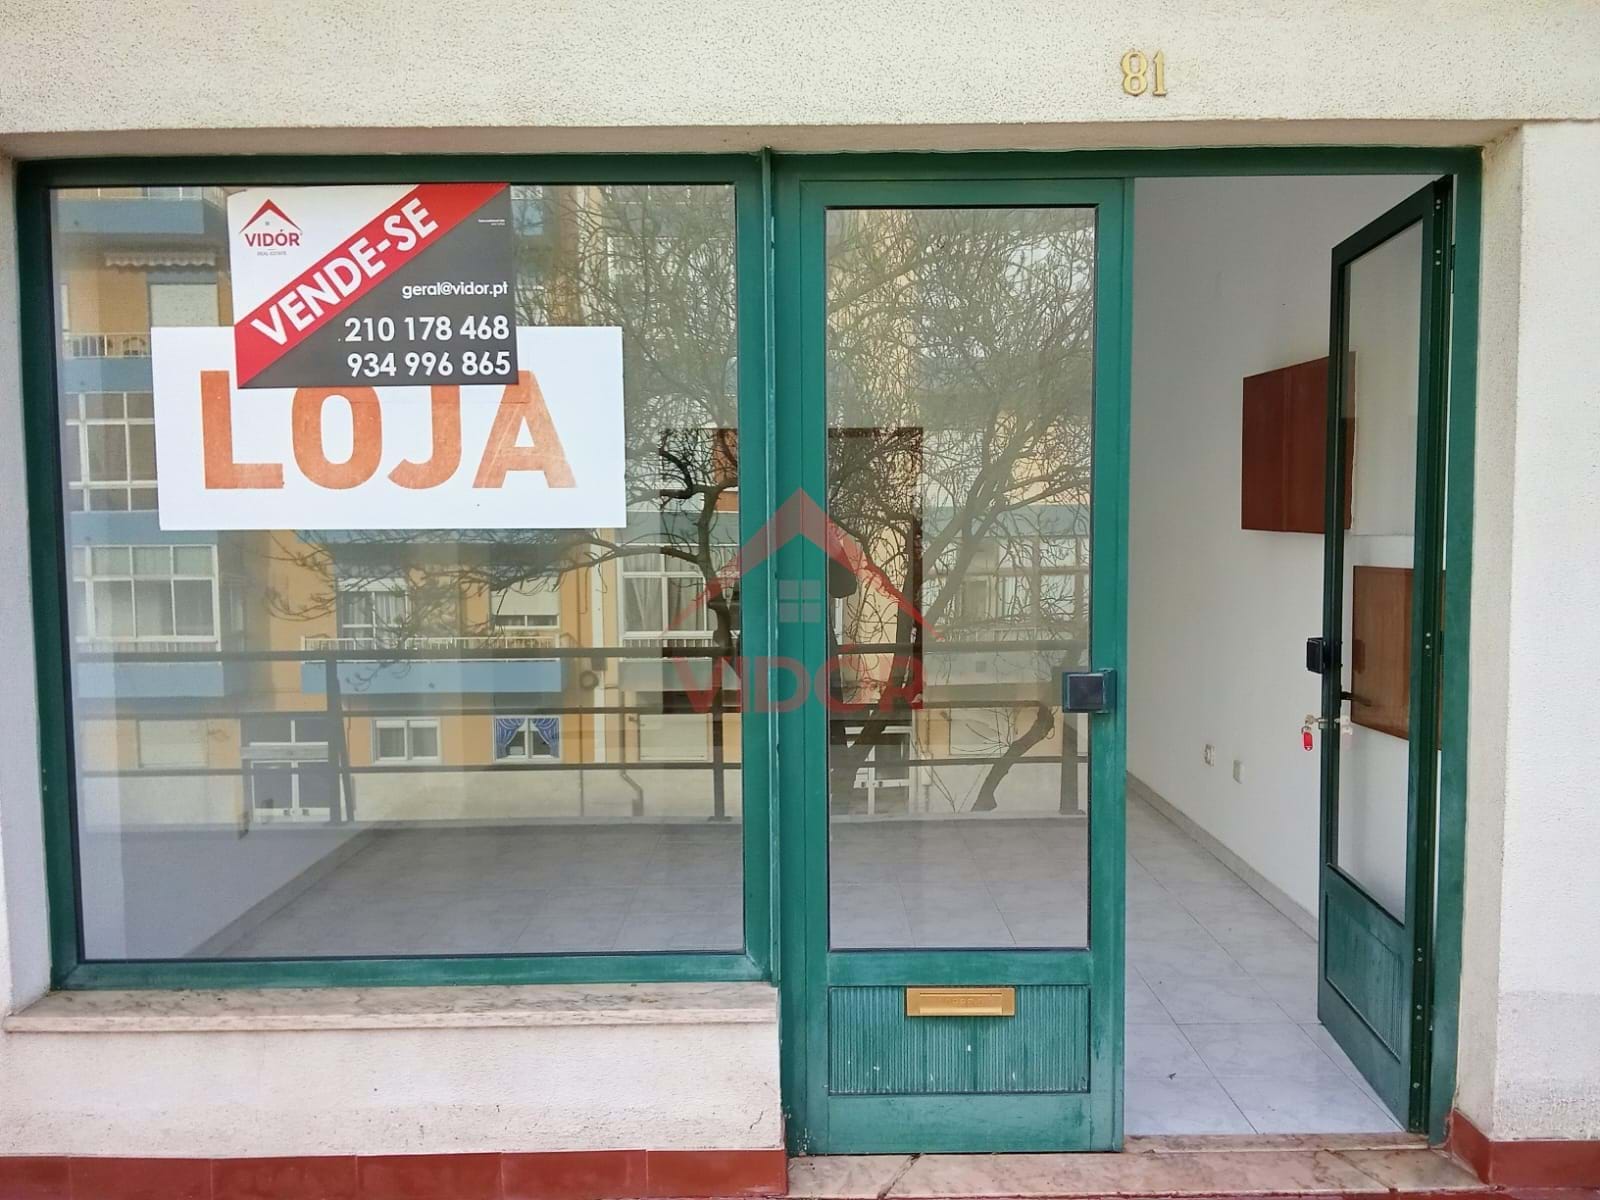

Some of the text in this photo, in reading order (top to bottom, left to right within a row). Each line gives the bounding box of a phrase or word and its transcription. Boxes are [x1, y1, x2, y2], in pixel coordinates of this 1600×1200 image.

[1120, 49, 1167, 97] 81
[244, 229, 300, 247] VIDÓR
[250, 197, 440, 346] VENDE-SE
[401, 281, 508, 299] geral@vidor.pt
[344, 314, 510, 342] 210 178 468
[347, 351, 511, 378] 934 996 865
[200, 370, 576, 490] LOJA
